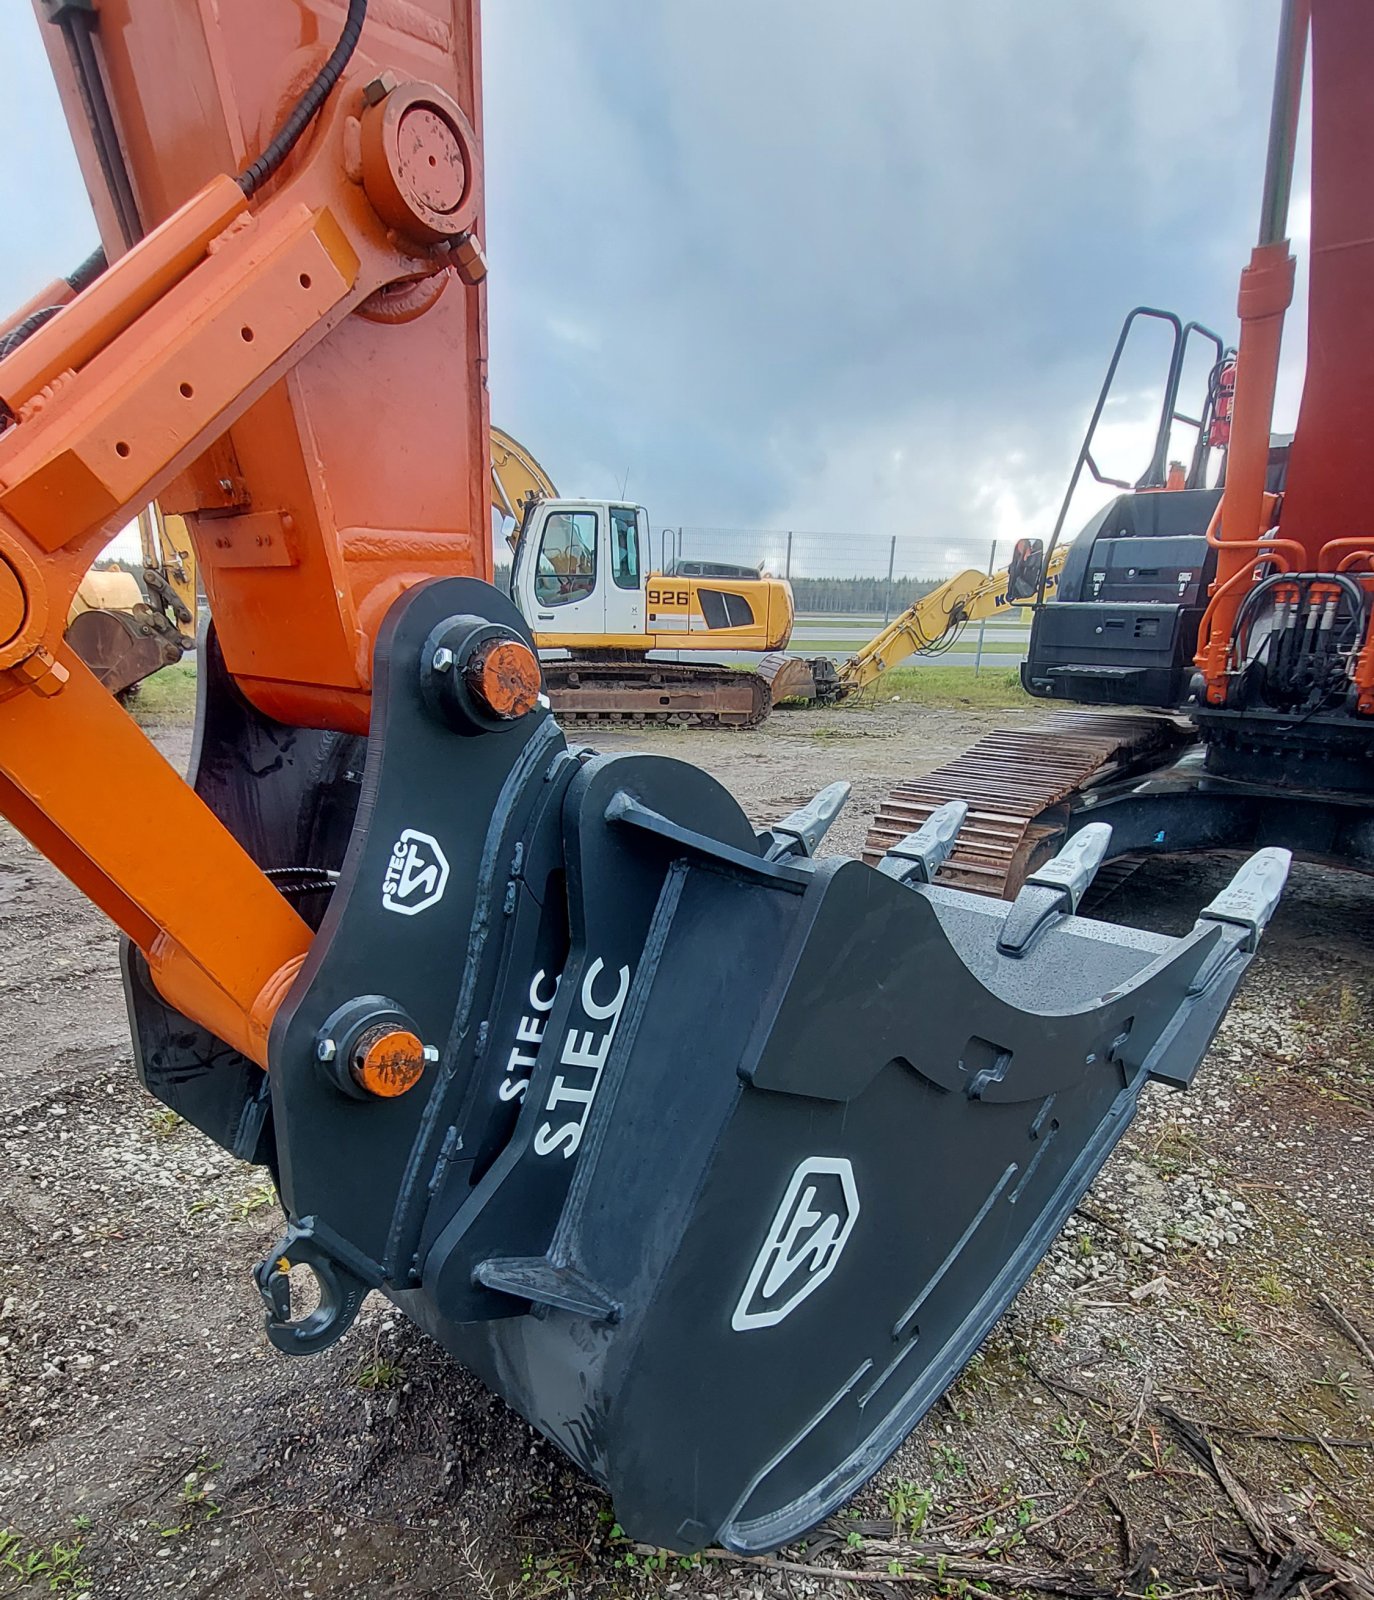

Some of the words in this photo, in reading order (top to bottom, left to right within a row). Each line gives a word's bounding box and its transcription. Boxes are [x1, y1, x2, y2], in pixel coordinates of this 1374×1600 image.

[648, 591, 689, 605] 926
[382, 841, 408, 895] STEC
[499, 969, 562, 1104] STEC
[534, 957, 629, 1158] STEC
